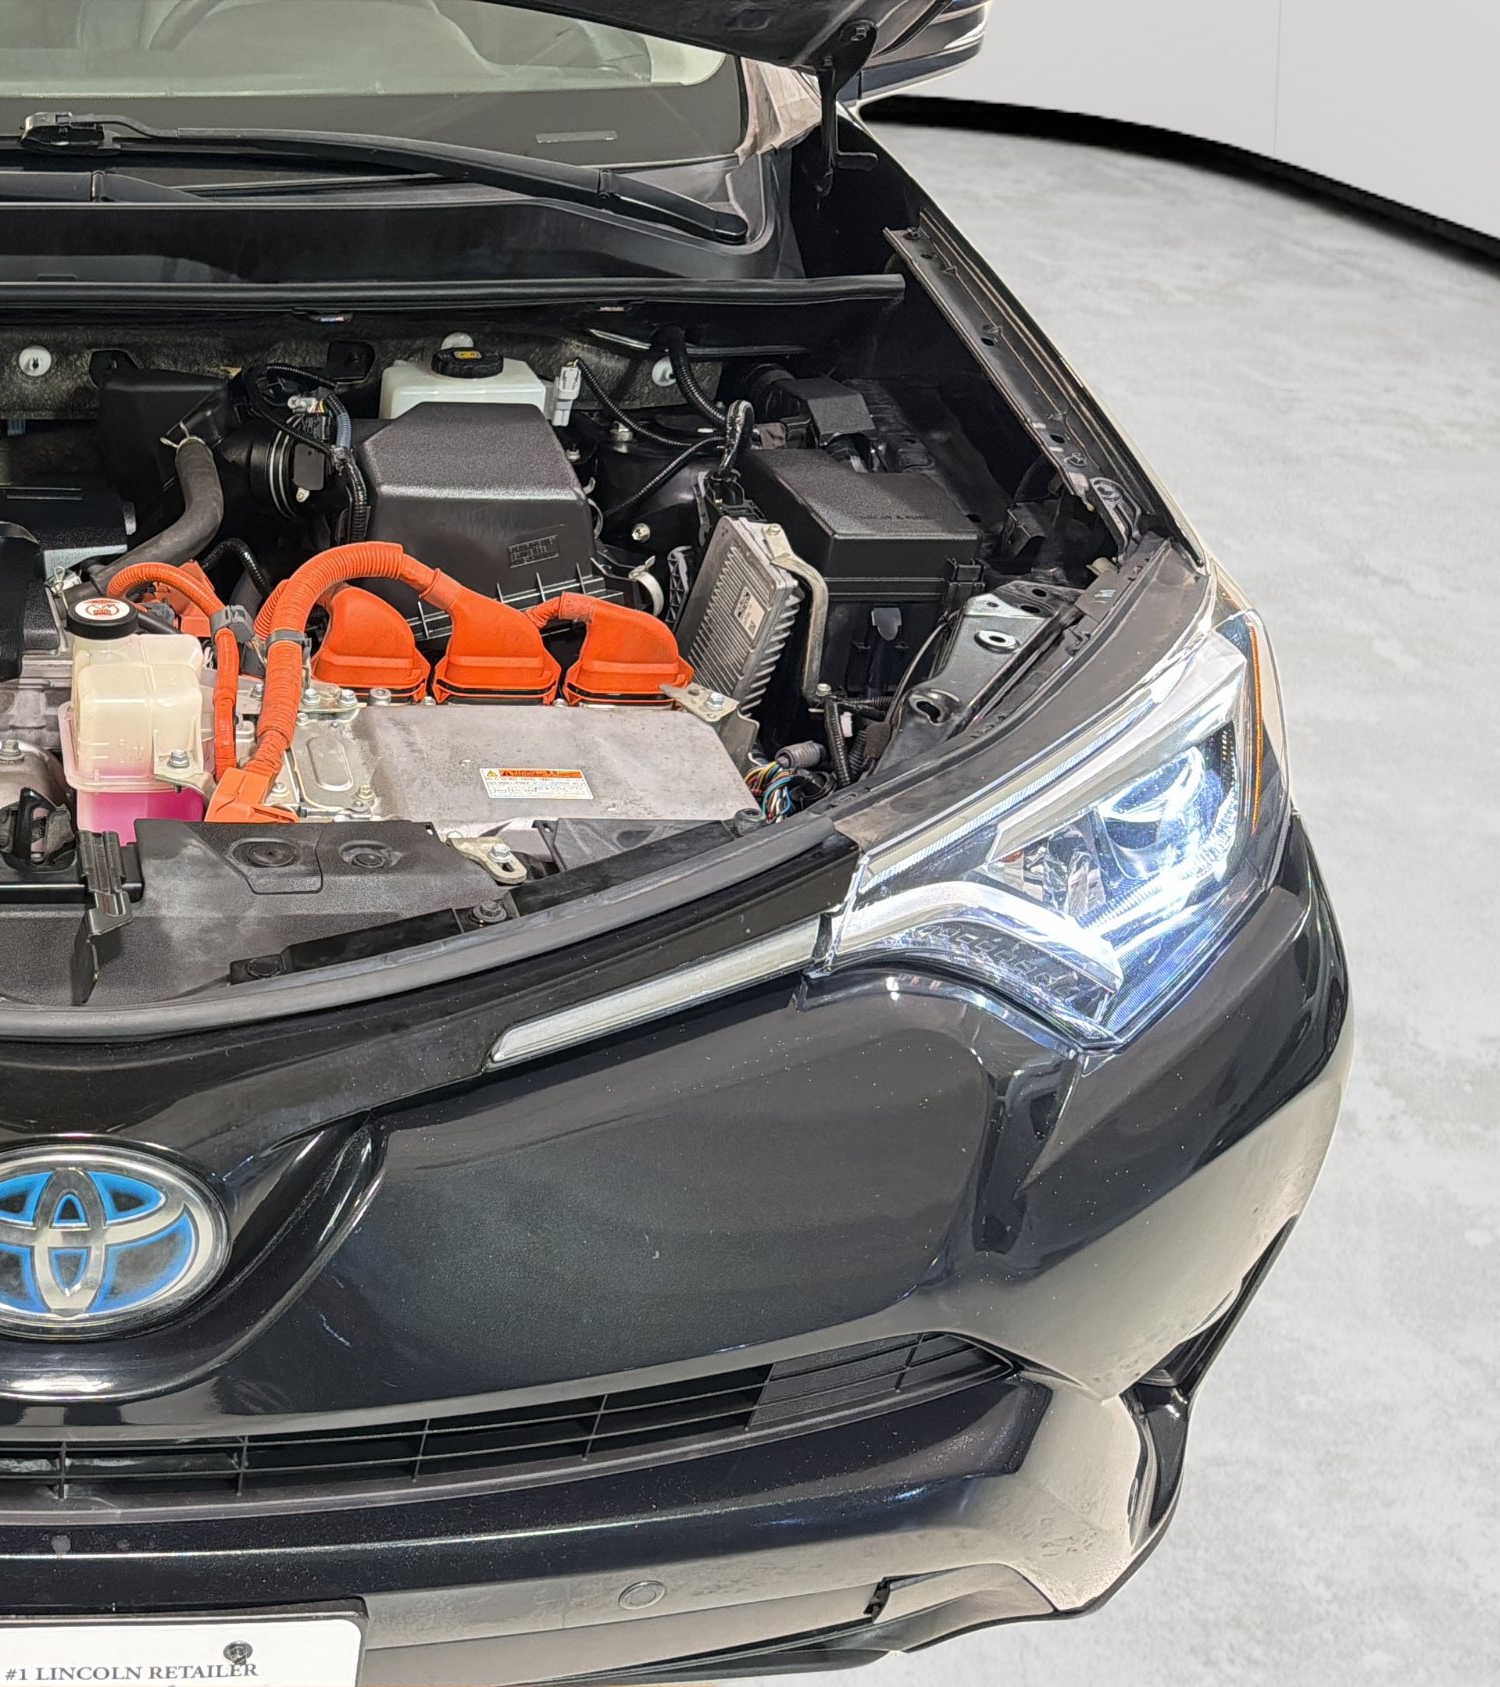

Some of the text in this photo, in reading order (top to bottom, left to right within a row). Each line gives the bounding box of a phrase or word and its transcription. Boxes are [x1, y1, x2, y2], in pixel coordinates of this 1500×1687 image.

[5, 1668, 29, 1681] #1
[35, 1666, 143, 1681] LINCOLN
[148, 1663, 259, 1680] RETAILER
